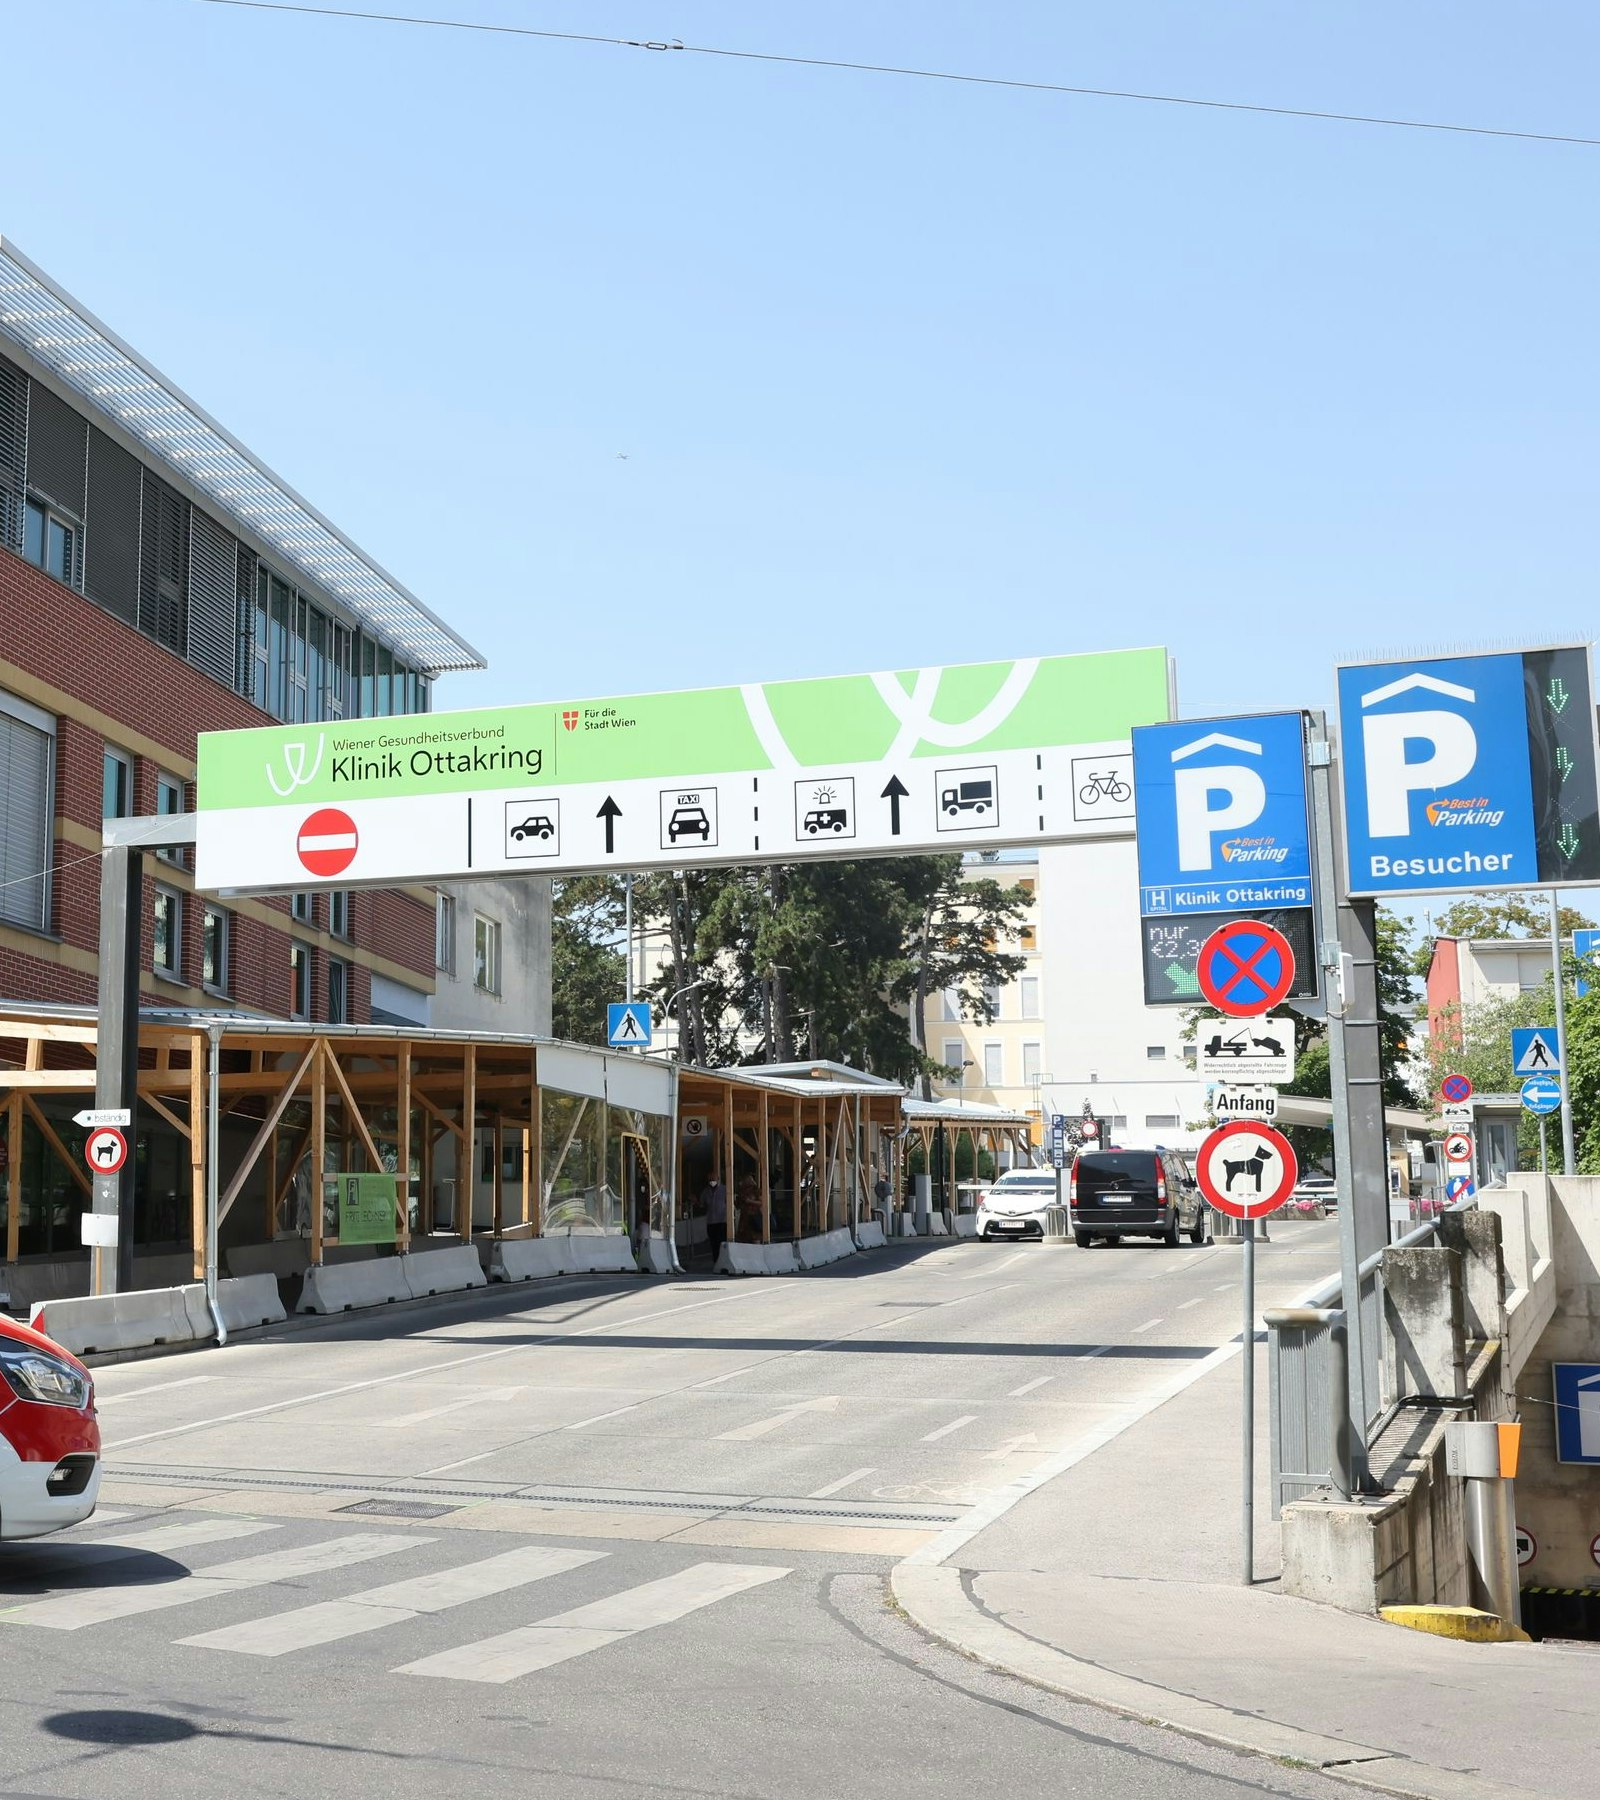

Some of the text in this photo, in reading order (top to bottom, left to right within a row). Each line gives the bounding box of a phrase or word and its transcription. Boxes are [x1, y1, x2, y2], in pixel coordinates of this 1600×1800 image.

[584, 707, 616, 719] Für die
[584, 716, 636, 730] Stadt Wien
[332, 726, 505, 752] Wiener Gesundheitsverbund
[331, 744, 544, 783] Klinik Ottakring
[1361, 710, 1477, 839] P
[678, 794, 700, 804] TAXI
[1448, 797, 1489, 810] Best in
[1174, 765, 1266, 872] P
[1435, 807, 1504, 827] Parking
[1241, 837, 1275, 847] Best in
[1228, 845, 1289, 863] Parking
[1370, 851, 1513, 878] Besucher
[1152, 890, 1165, 906] H
[1175, 886, 1306, 906] Klinik Ottakring
[1150, 926, 1189, 940] nur
[1151, 939, 1205, 959] €2,3
[1217, 1093, 1275, 1115] Anfang
